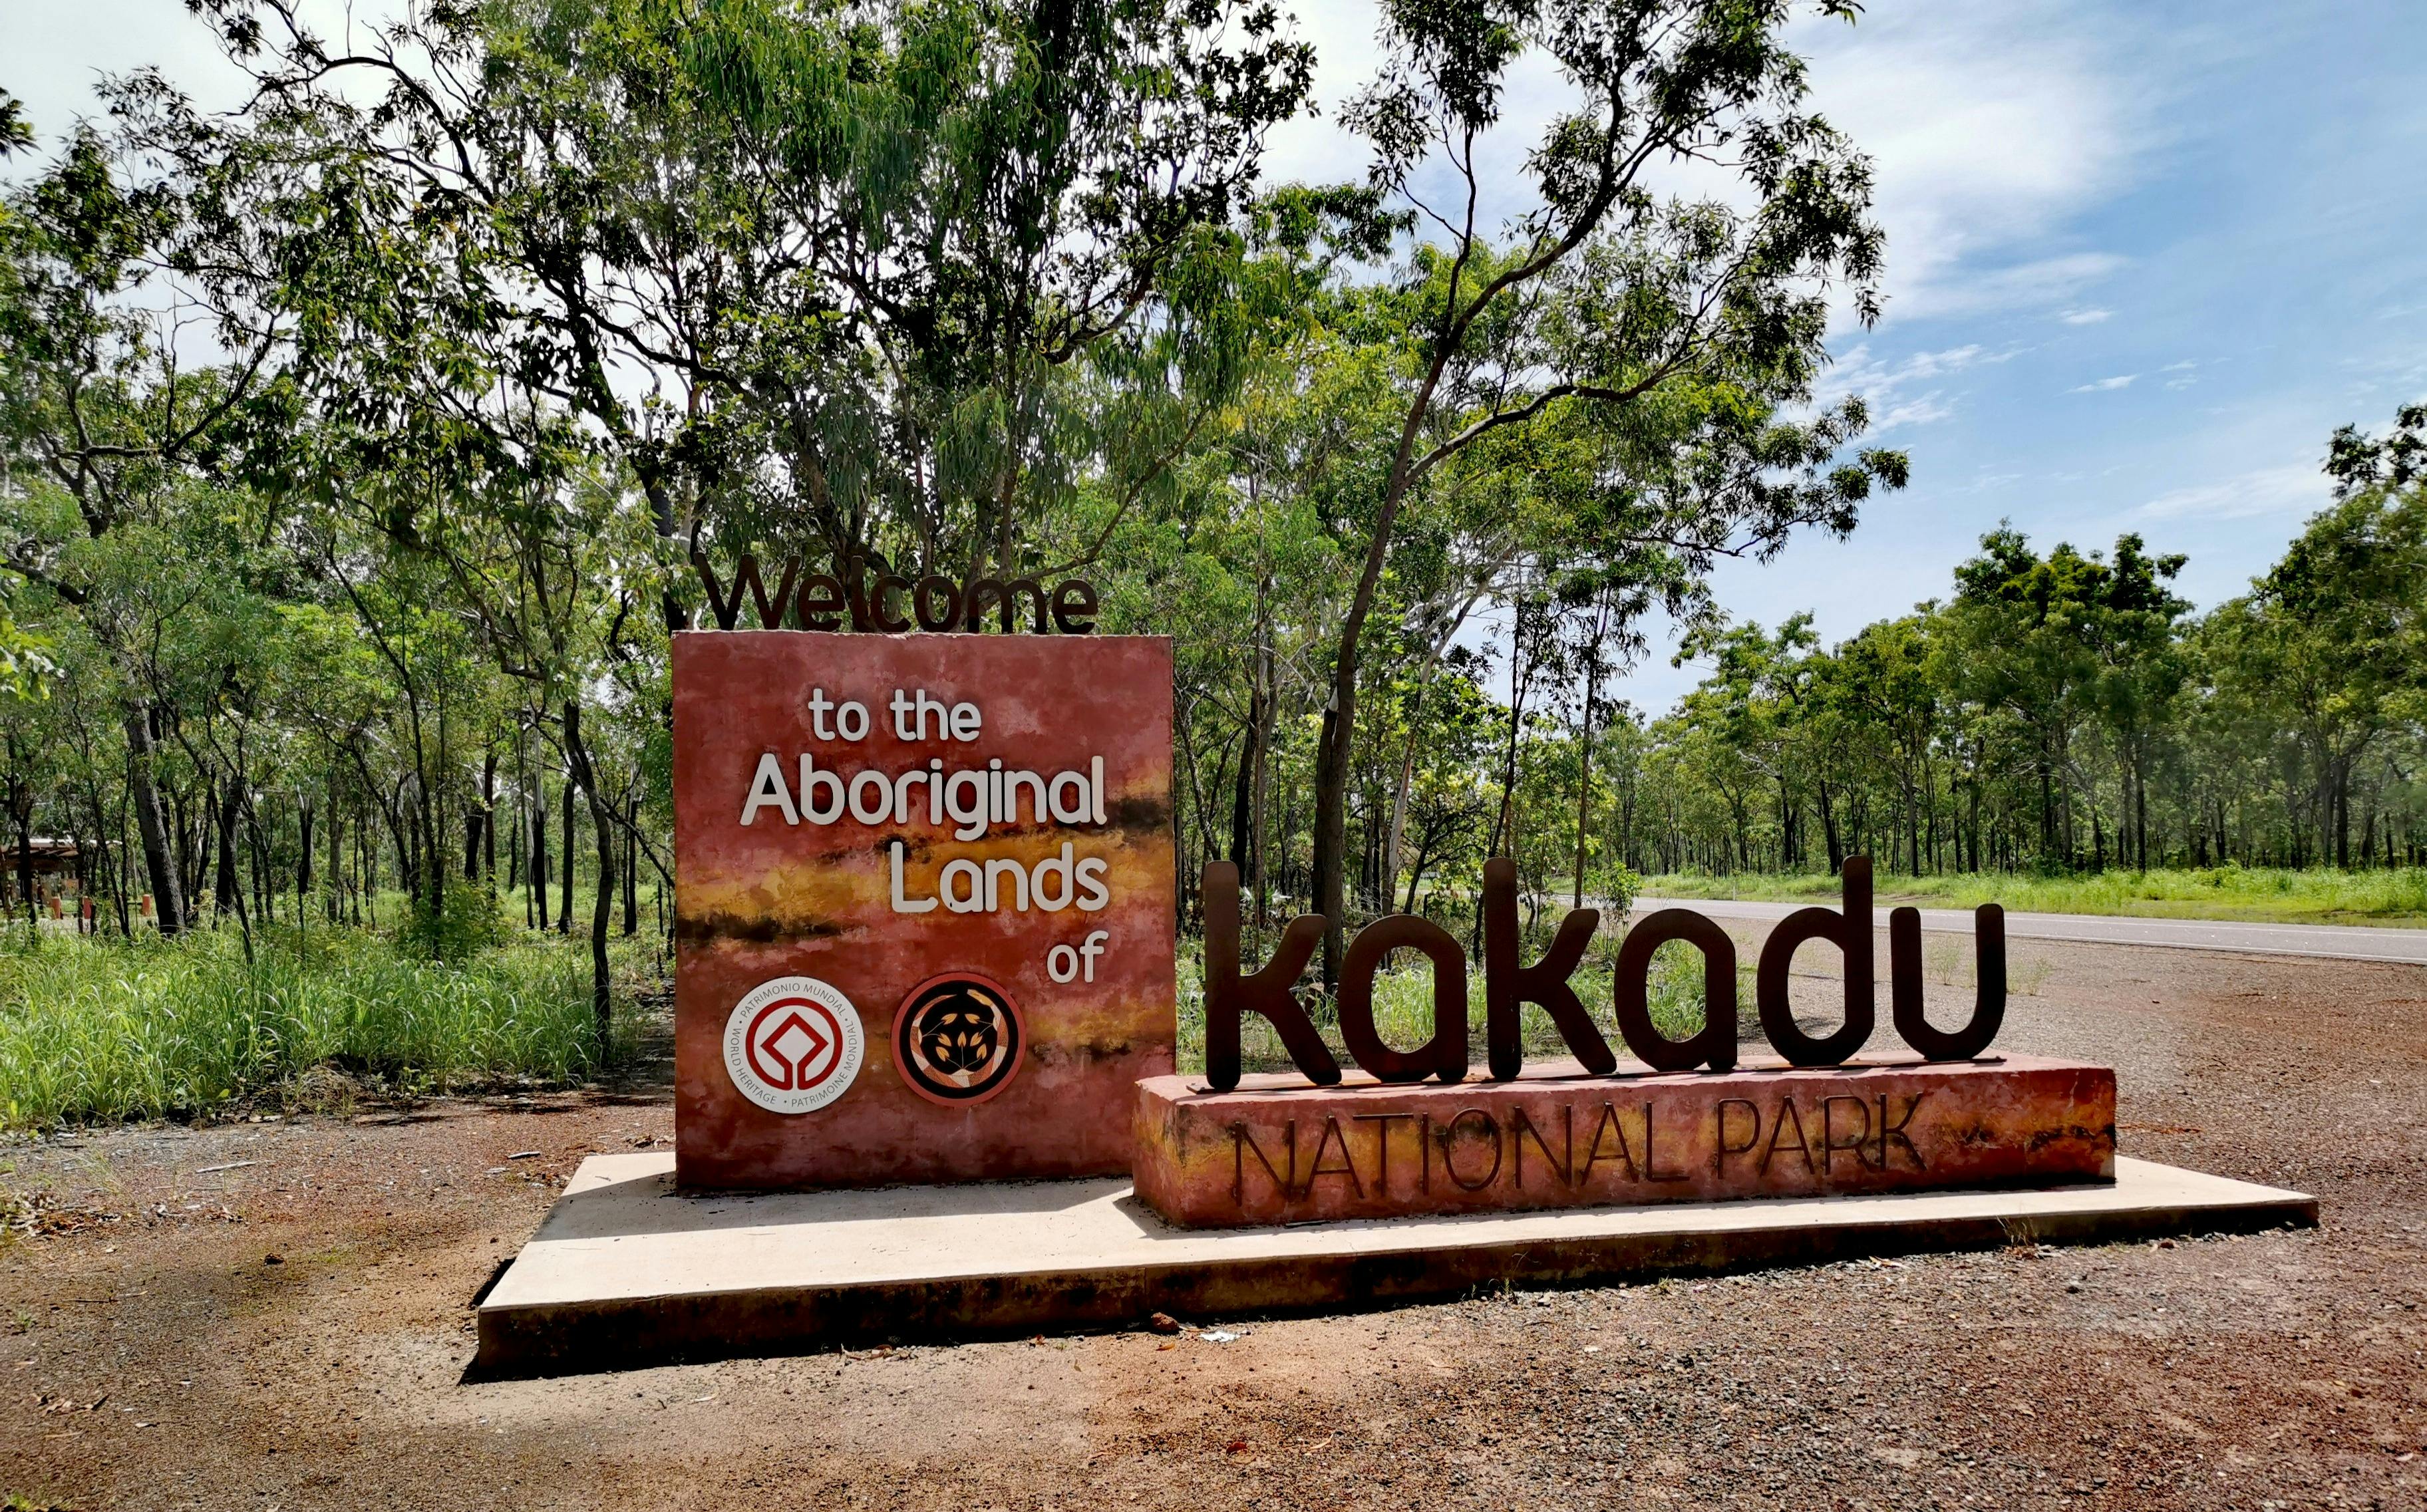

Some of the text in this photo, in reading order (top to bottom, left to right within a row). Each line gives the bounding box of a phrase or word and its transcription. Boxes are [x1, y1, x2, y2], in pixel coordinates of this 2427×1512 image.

[694, 552, 1098, 634] Welcome
[808, 688, 982, 741] to the
[740, 753, 1107, 841] Aboriginal
[890, 841, 1109, 913] Lands
[1047, 931, 1108, 983] of
[1204, 855, 2006, 1091] kakadu
[740, 983, 847, 1018] PATRIMONIO MUNDIAL
[730, 1028, 777, 1105] WORLD HERITAGE
[791, 1021, 857, 1108] PATRIMOINE MONDIAL
[1234, 1092, 1925, 1207] NATIONAL PARK
